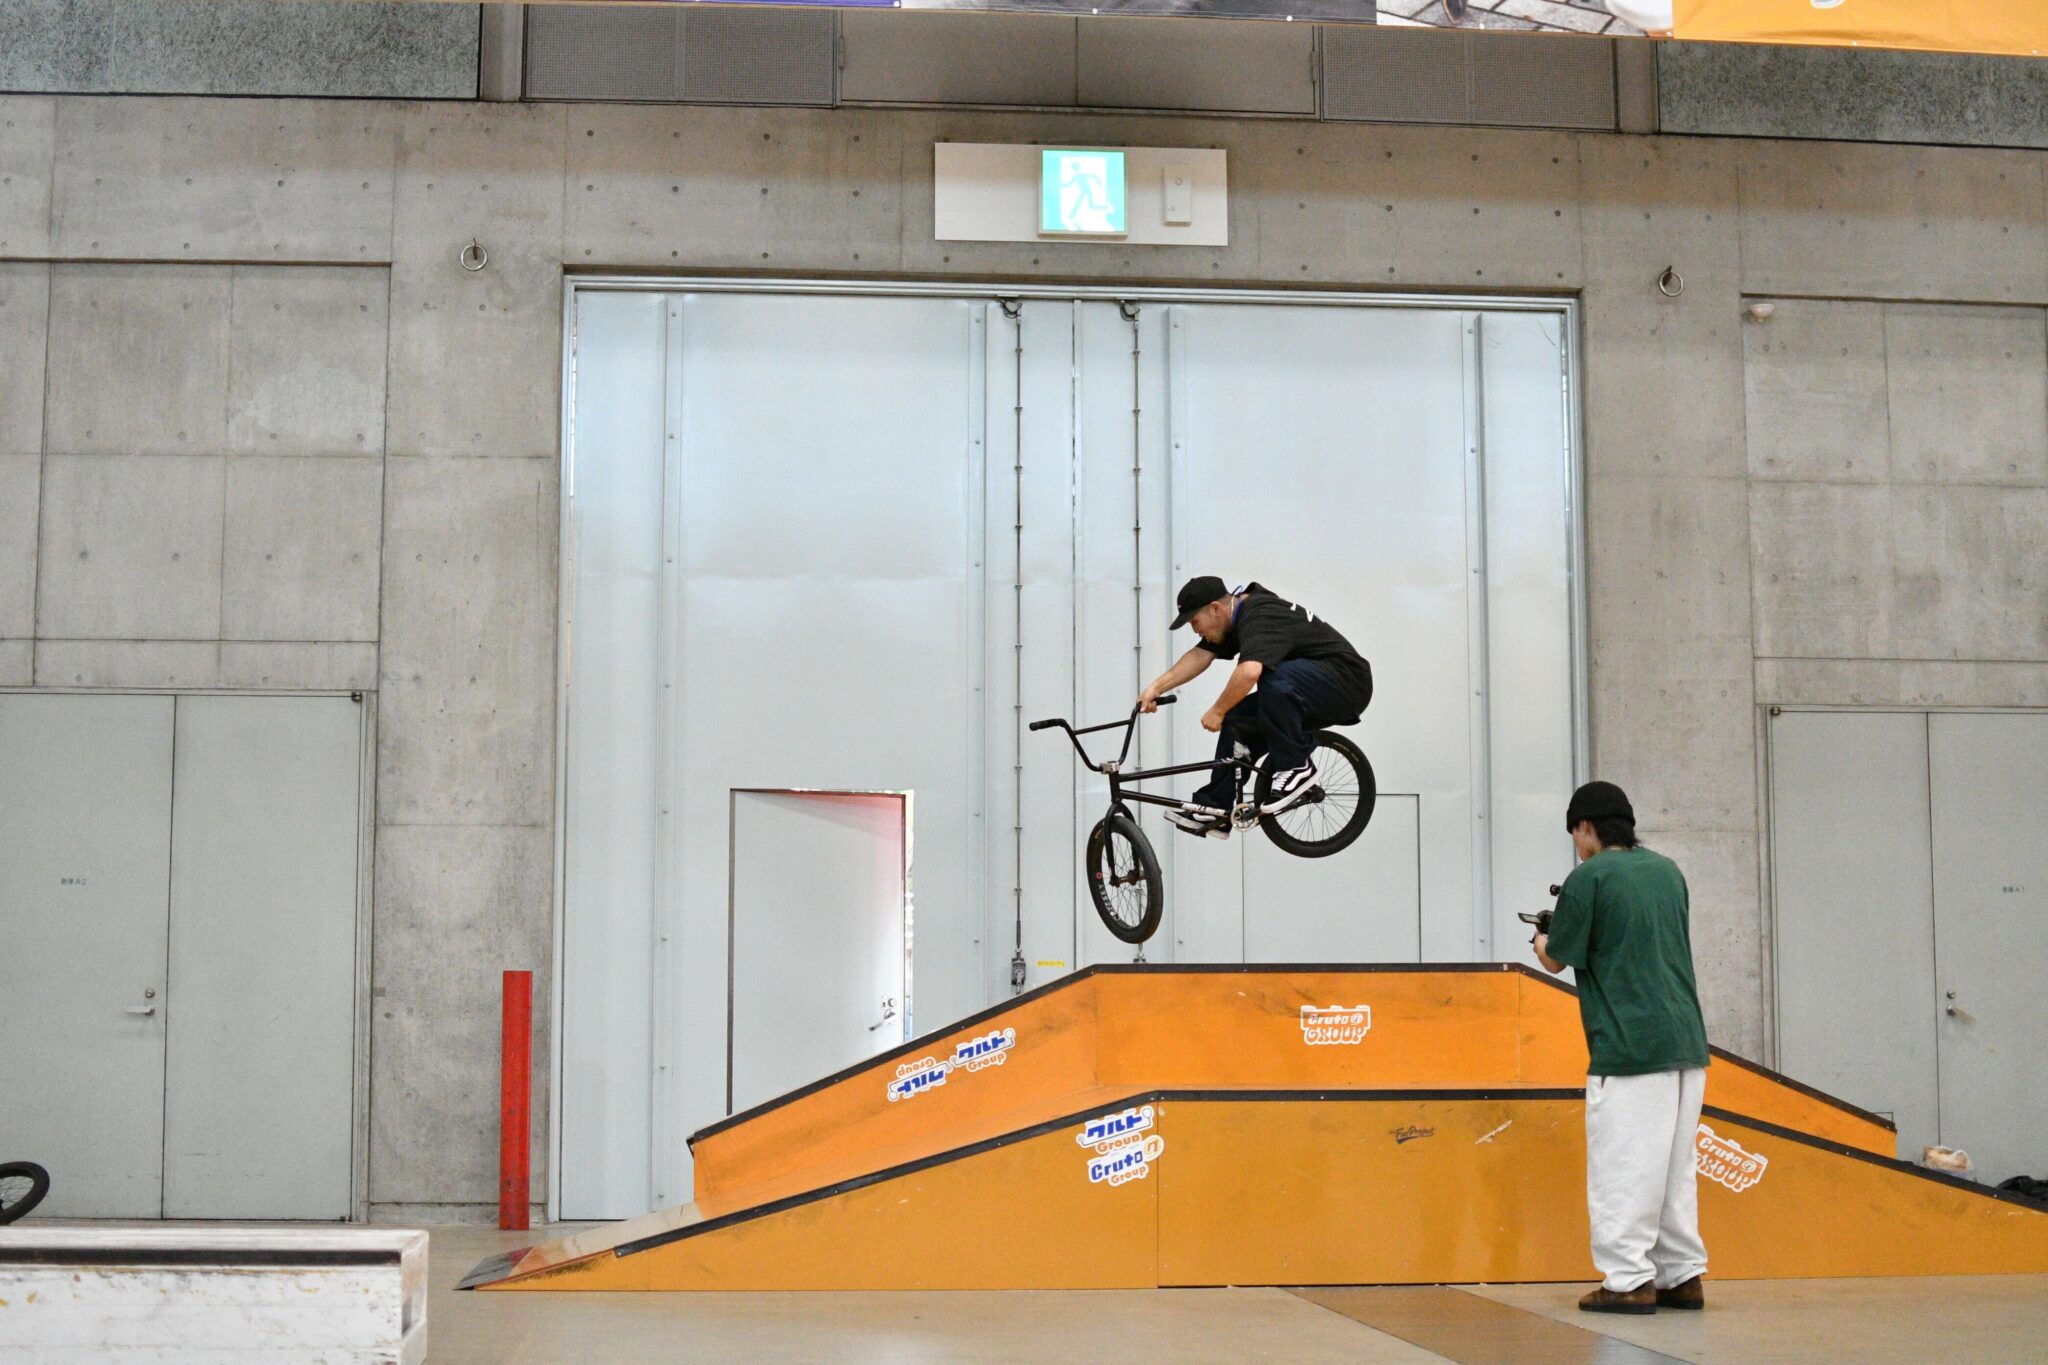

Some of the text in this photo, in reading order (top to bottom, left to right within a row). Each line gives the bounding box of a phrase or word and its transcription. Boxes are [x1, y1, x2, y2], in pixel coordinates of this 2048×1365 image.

[1306, 1027, 1364, 1043] GROUP
[898, 1058, 935, 1076] Group
[968, 1054, 1005, 1071] Group
[1097, 1133, 1141, 1152] Group
[1699, 1137, 1742, 1166] Cruto
[1091, 1150, 1143, 1181] Cruto
[1111, 1166, 1147, 1184] Group
